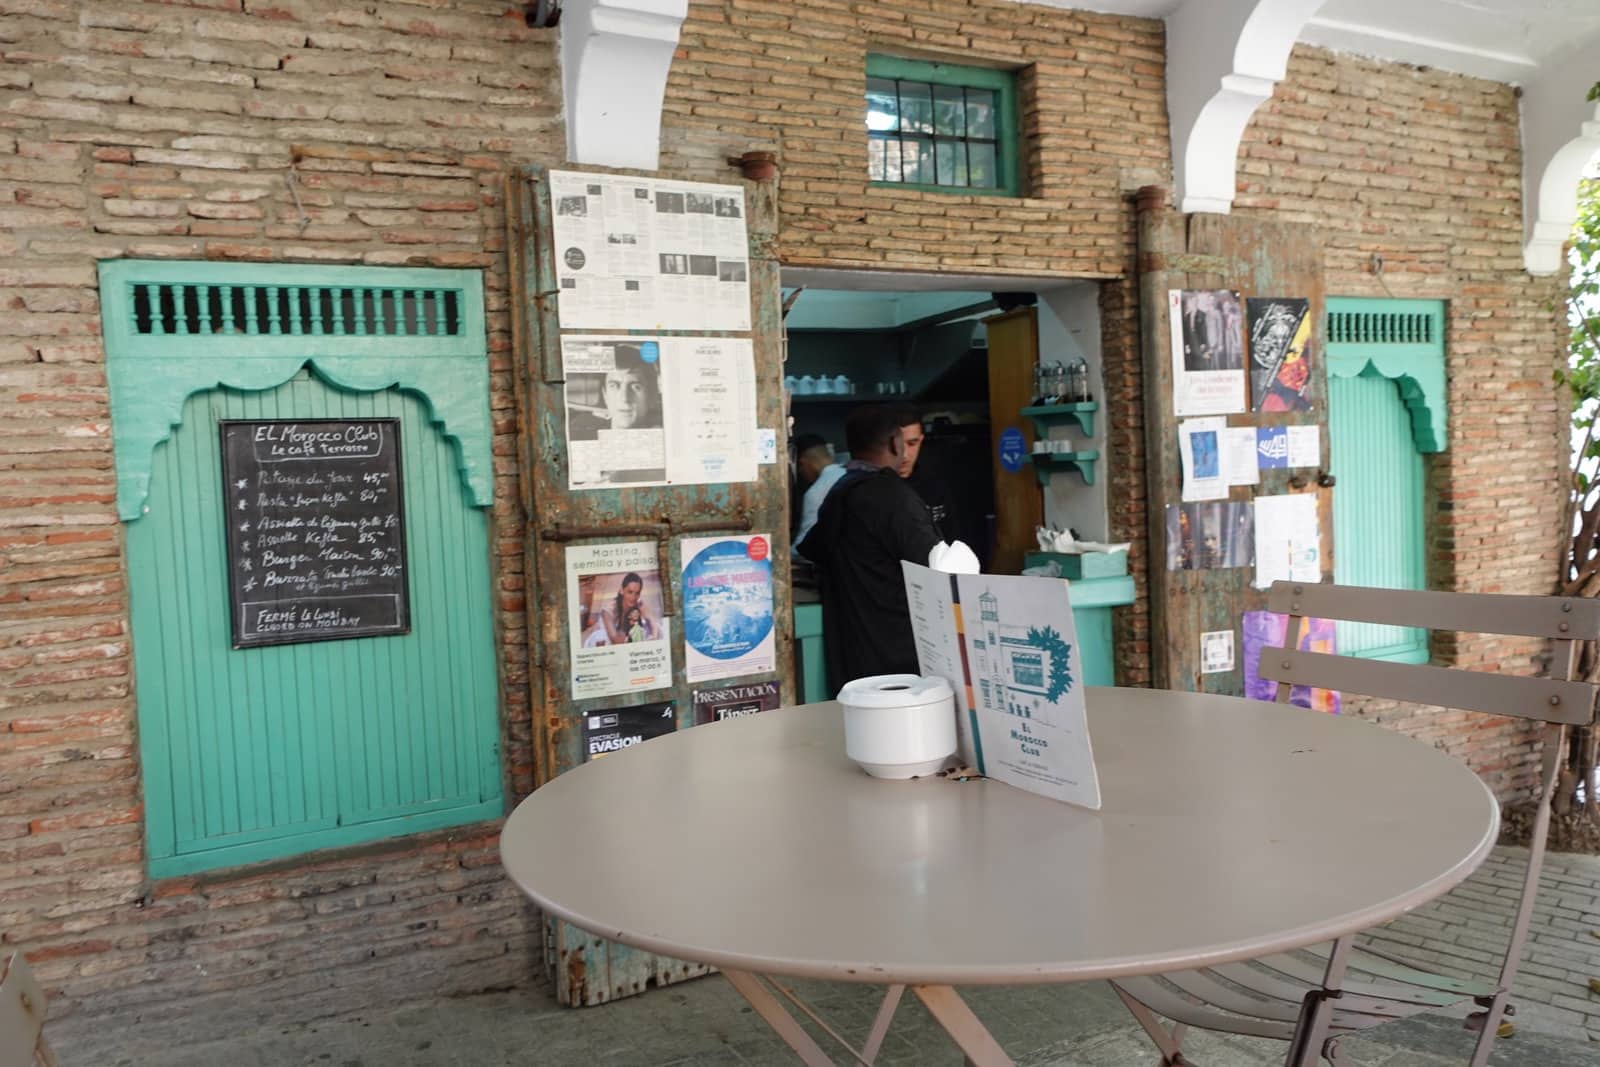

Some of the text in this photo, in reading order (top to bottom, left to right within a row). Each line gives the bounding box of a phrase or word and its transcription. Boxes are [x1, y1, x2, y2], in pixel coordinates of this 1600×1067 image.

[280, 424, 342, 442] Morocco
[344, 425, 378, 443] Club
[271, 444, 286, 456] Le
[573, 560, 614, 570] semilla
[626, 556, 658, 568] paisaj
[590, 735, 642, 754] EVASION
